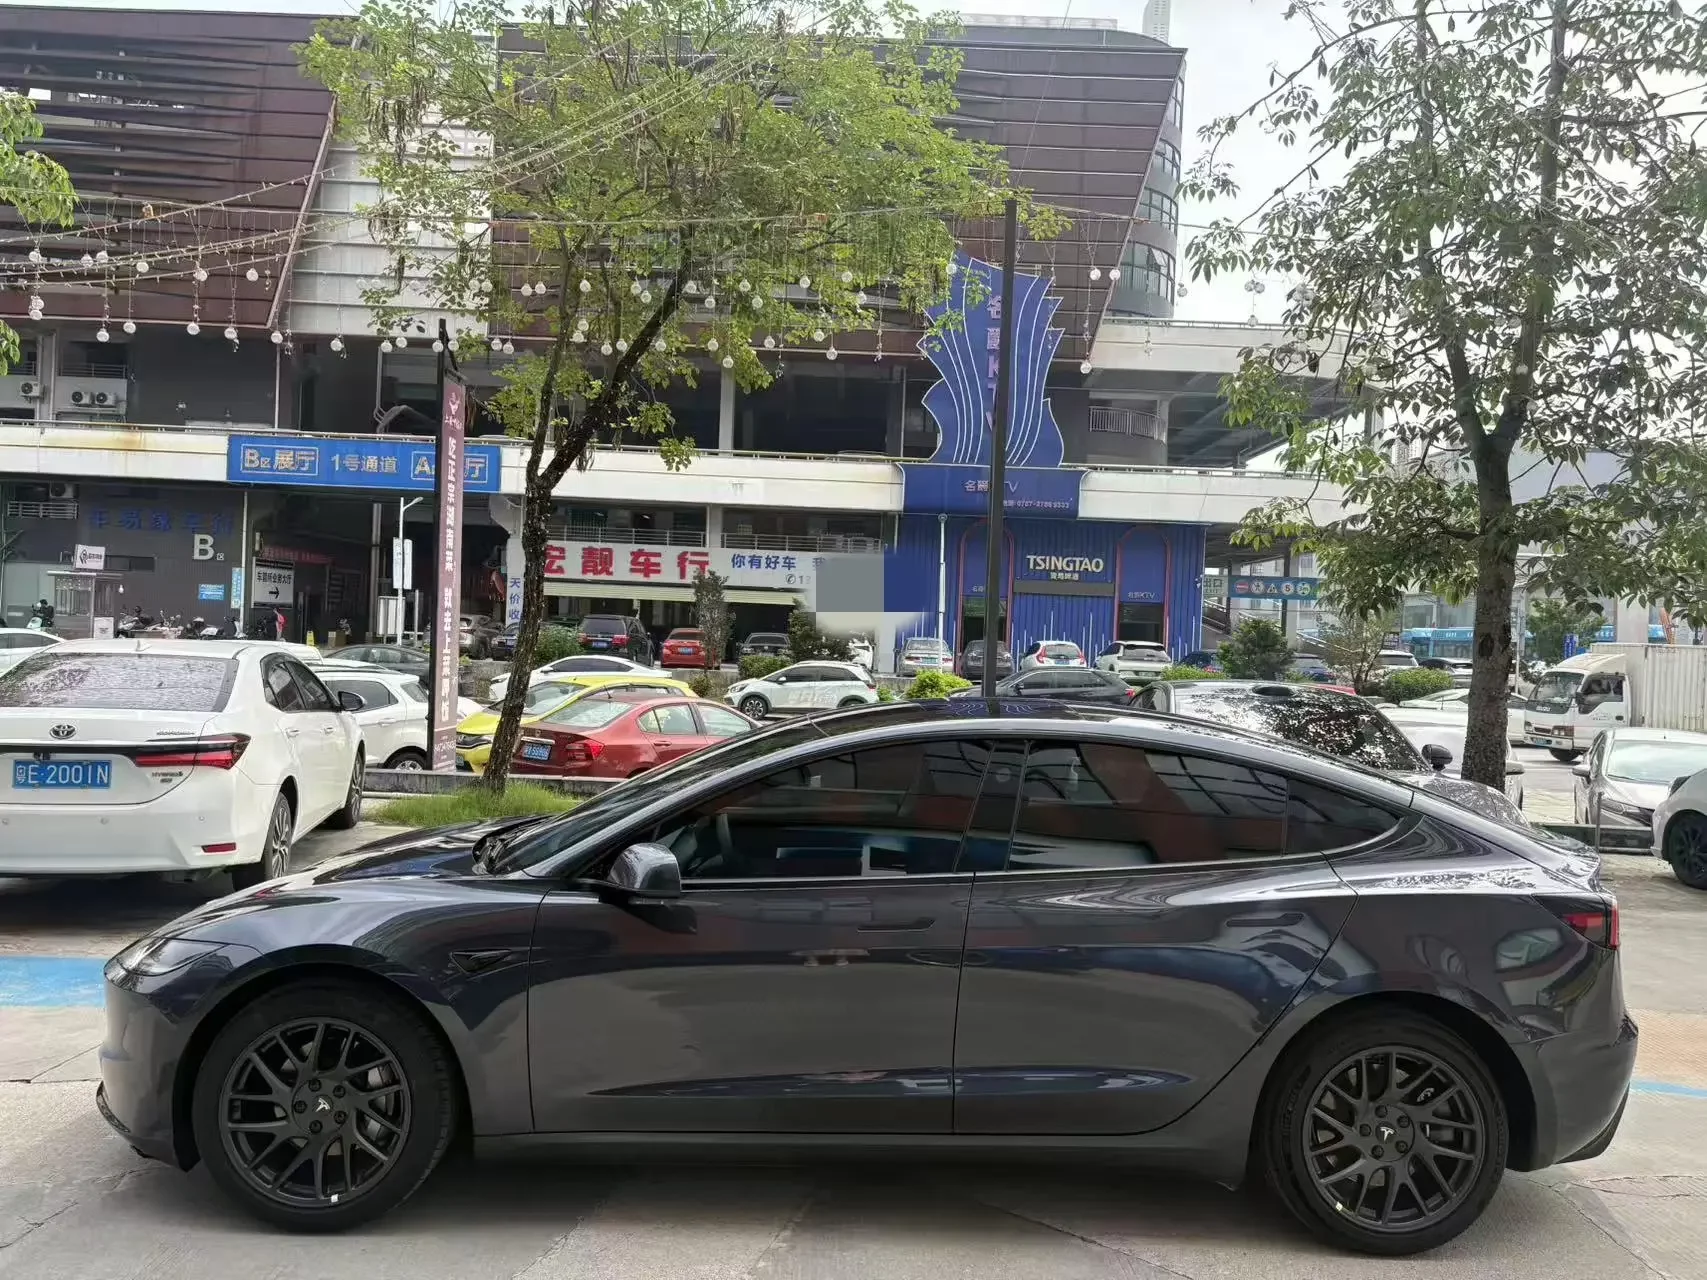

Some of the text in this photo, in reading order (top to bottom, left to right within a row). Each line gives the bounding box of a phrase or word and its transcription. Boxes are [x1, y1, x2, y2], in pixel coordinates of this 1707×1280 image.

[243, 448, 316, 472] B区展厅
[331, 454, 398, 473] 1号通道
[414, 455, 486, 478] A厅
[730, 553, 797, 571] 你有好车
[1026, 554, 1104, 573] TSINGTAO
